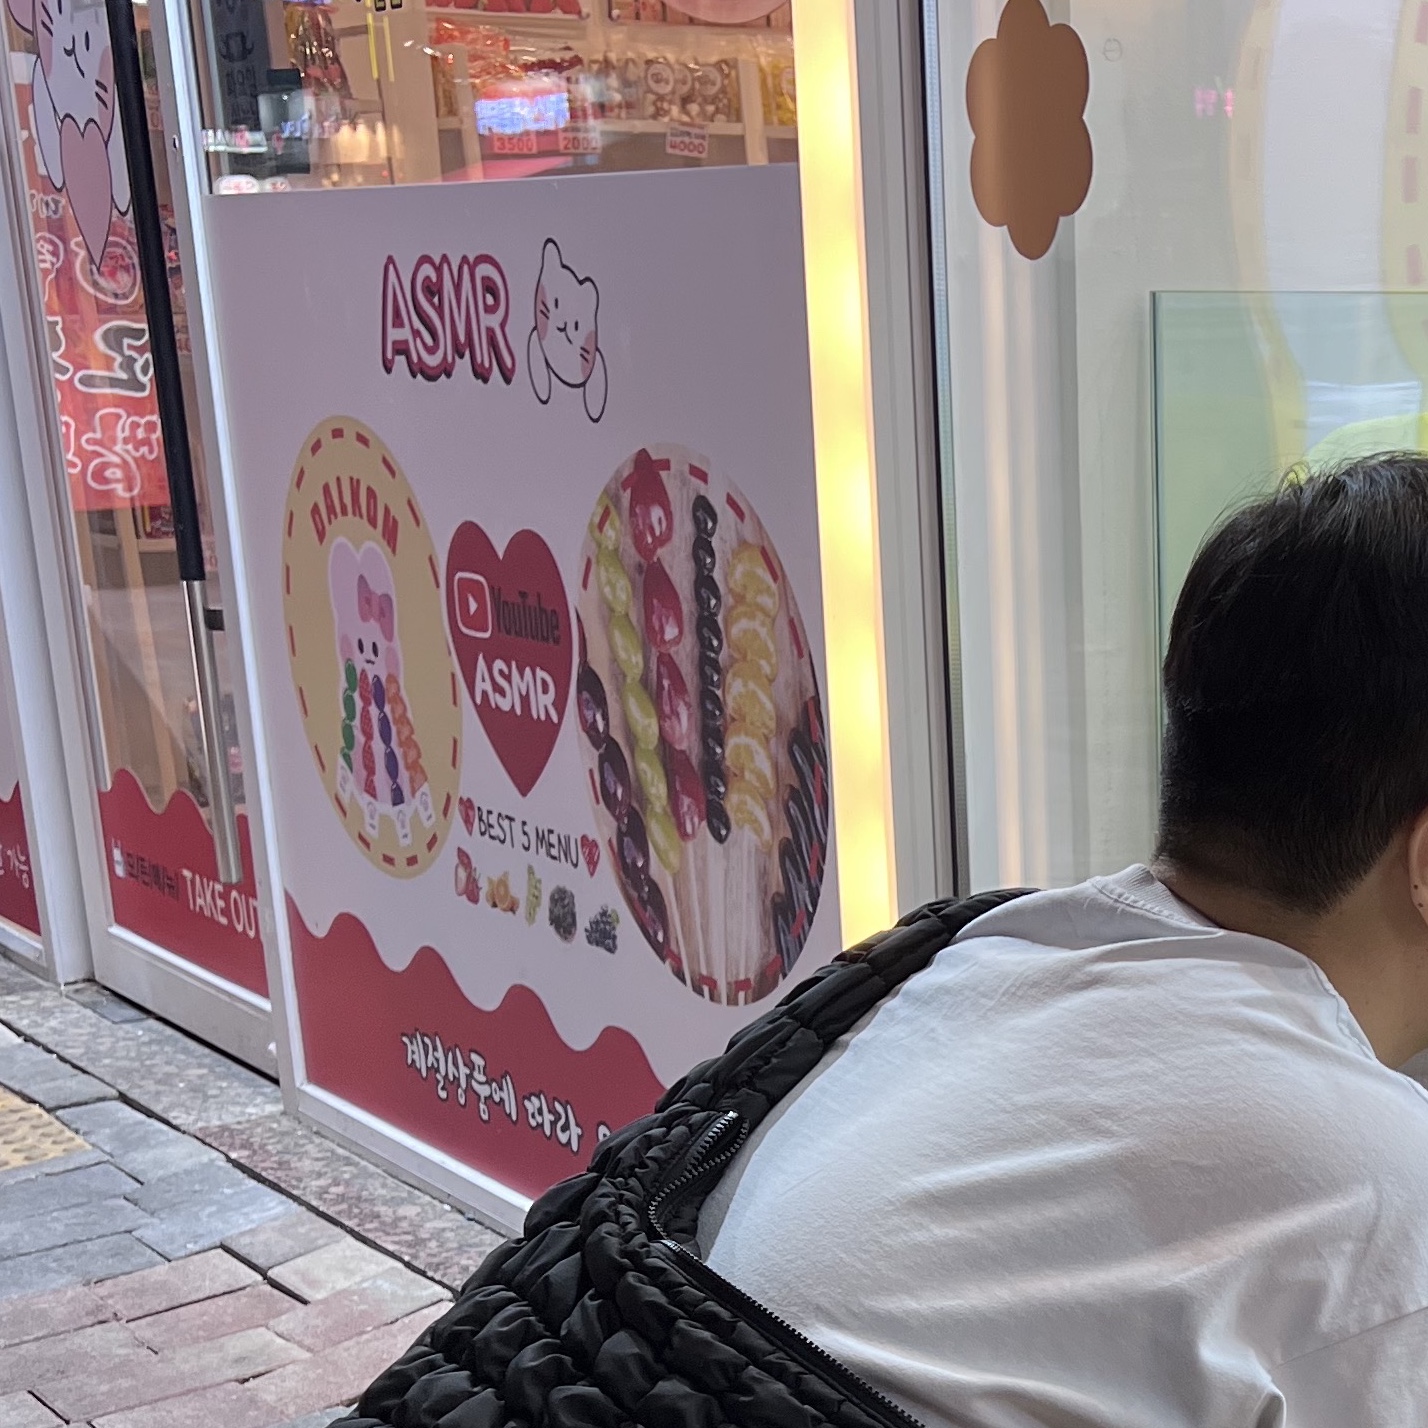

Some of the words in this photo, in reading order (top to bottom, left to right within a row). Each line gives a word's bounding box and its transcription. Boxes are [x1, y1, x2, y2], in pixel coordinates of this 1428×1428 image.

[381, 253, 516, 385] ASMR
[310, 475, 399, 556] DALKOM
[474, 652, 559, 725] ASMR
[476, 805, 516, 849] BEST
[520, 820, 531, 852] 5
[535, 825, 580, 869] MENU
[181, 868, 228, 925] TAKE
[523, 1093, 583, 1154] 따라
